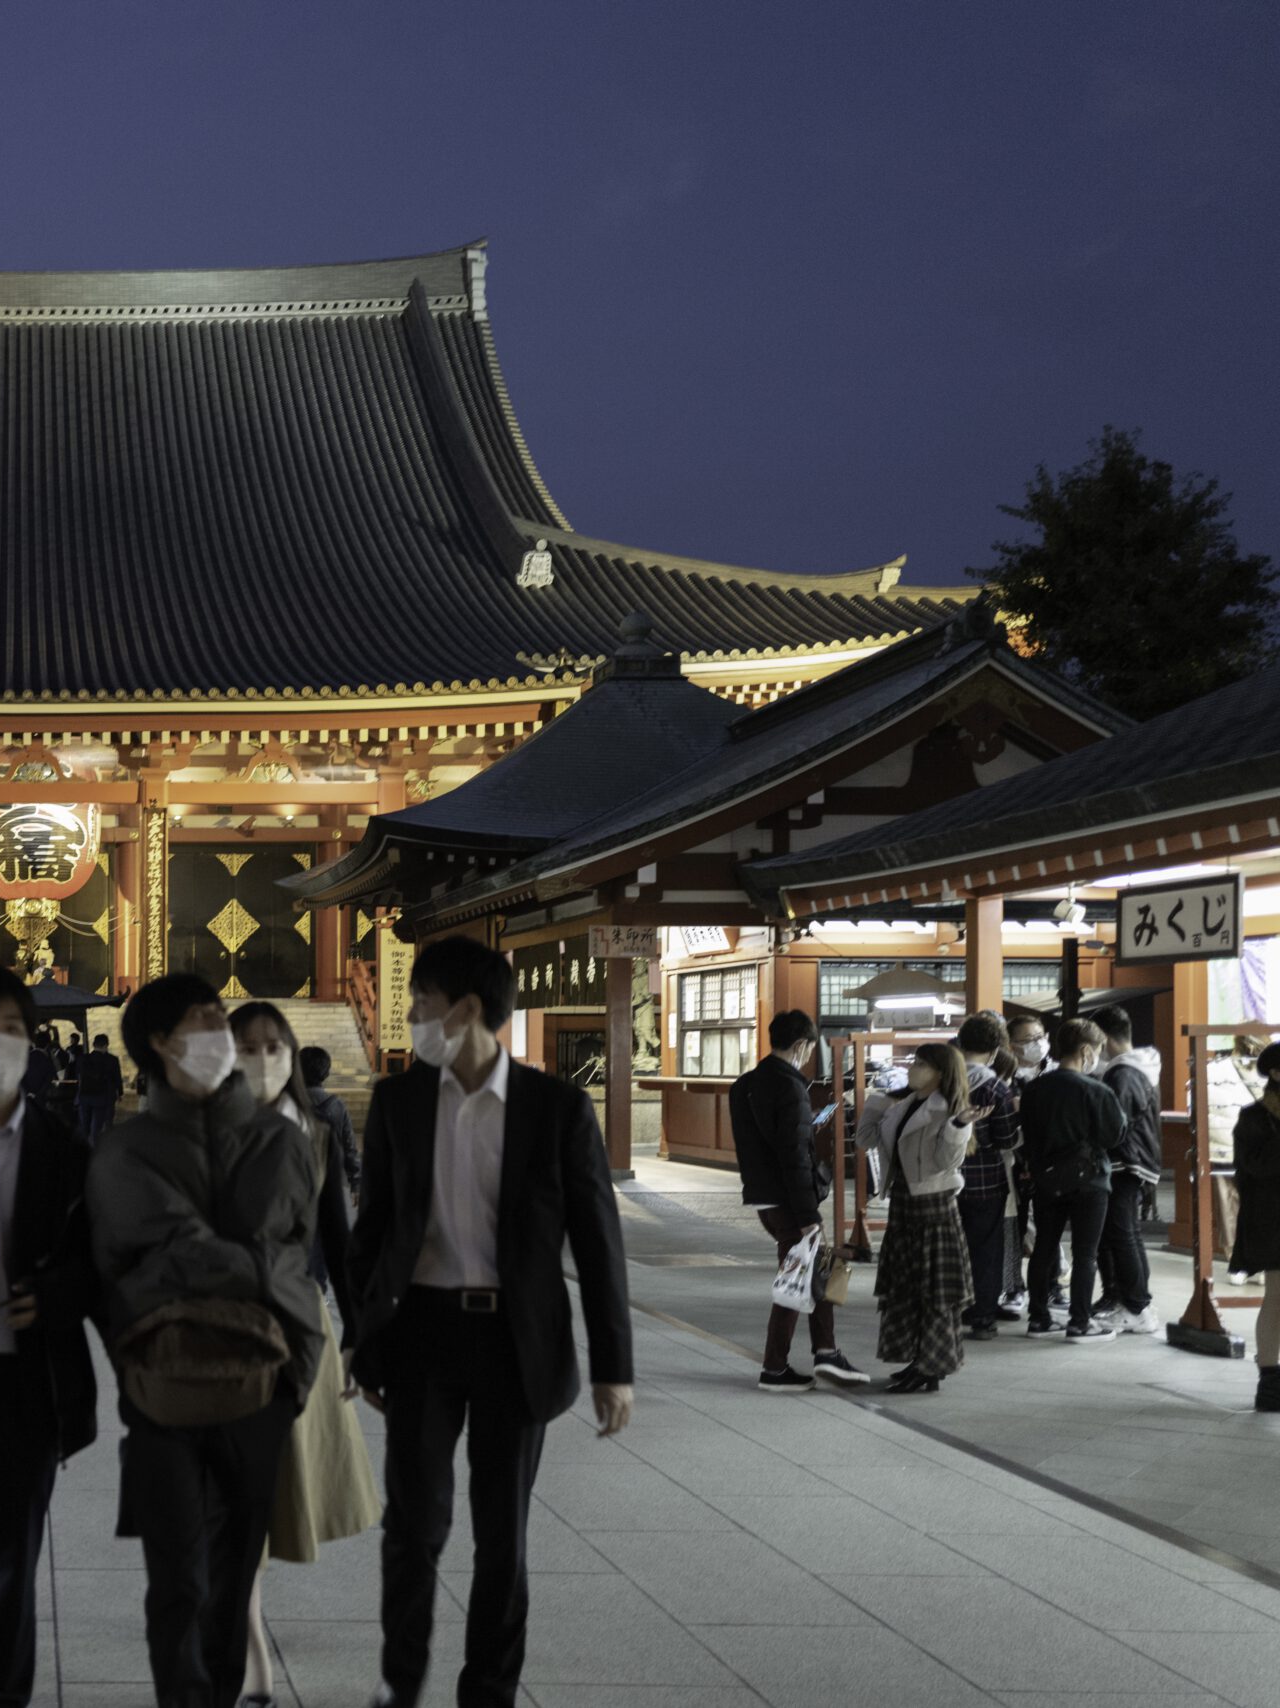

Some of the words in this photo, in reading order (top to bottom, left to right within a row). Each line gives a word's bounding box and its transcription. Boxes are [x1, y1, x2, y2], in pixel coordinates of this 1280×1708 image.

[611, 928, 655, 947] 朱印所
[1133, 894, 1227, 947] みくじ
